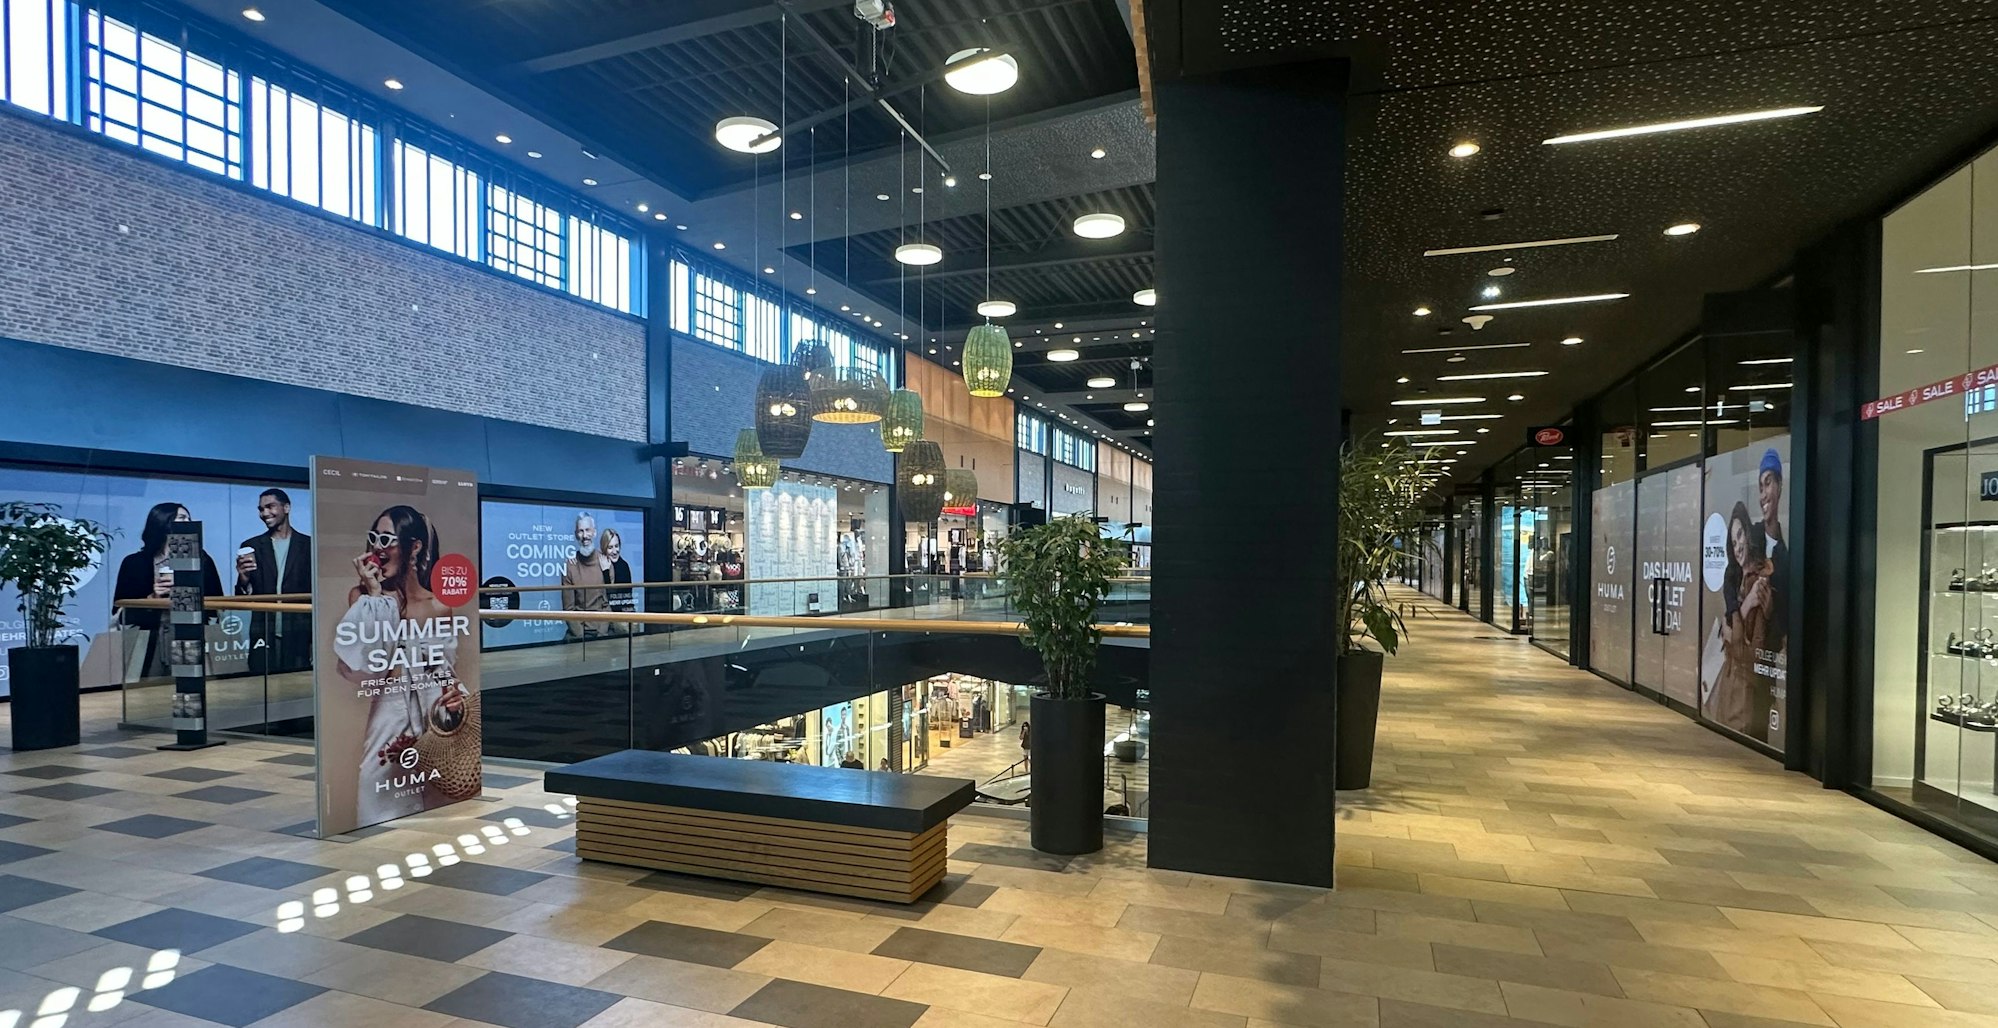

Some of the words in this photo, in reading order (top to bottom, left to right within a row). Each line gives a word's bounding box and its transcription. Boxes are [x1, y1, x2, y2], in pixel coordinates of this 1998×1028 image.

[1876, 396, 1903, 414] SALE
[1922, 381, 1953, 400] SALE
[506, 544, 577, 559] COMING
[441, 566, 455, 575] BIS
[456, 566, 468, 575] ZU
[517, 562, 568, 577] SOON
[1643, 561, 1661, 580] DAS
[1662, 562, 1693, 583] HUMA
[441, 588, 468, 596] RABATT
[1597, 582, 1624, 600] HUMA
[1648, 584, 1686, 607] OULET
[0, 631, 26, 642] EHR
[336, 615, 471, 646] SUMMER
[215, 652, 250, 661] OUTLET
[367, 644, 446, 673] SALE
[361, 675, 408, 688] FRISCHE
[412, 670, 452, 682] STYLES
[357, 687, 381, 698] FÜR
[384, 685, 407, 695] DEN
[411, 679, 455, 691] SOMMER
[375, 768, 442, 793] HUMA
[394, 785, 425, 799] OUTLET
